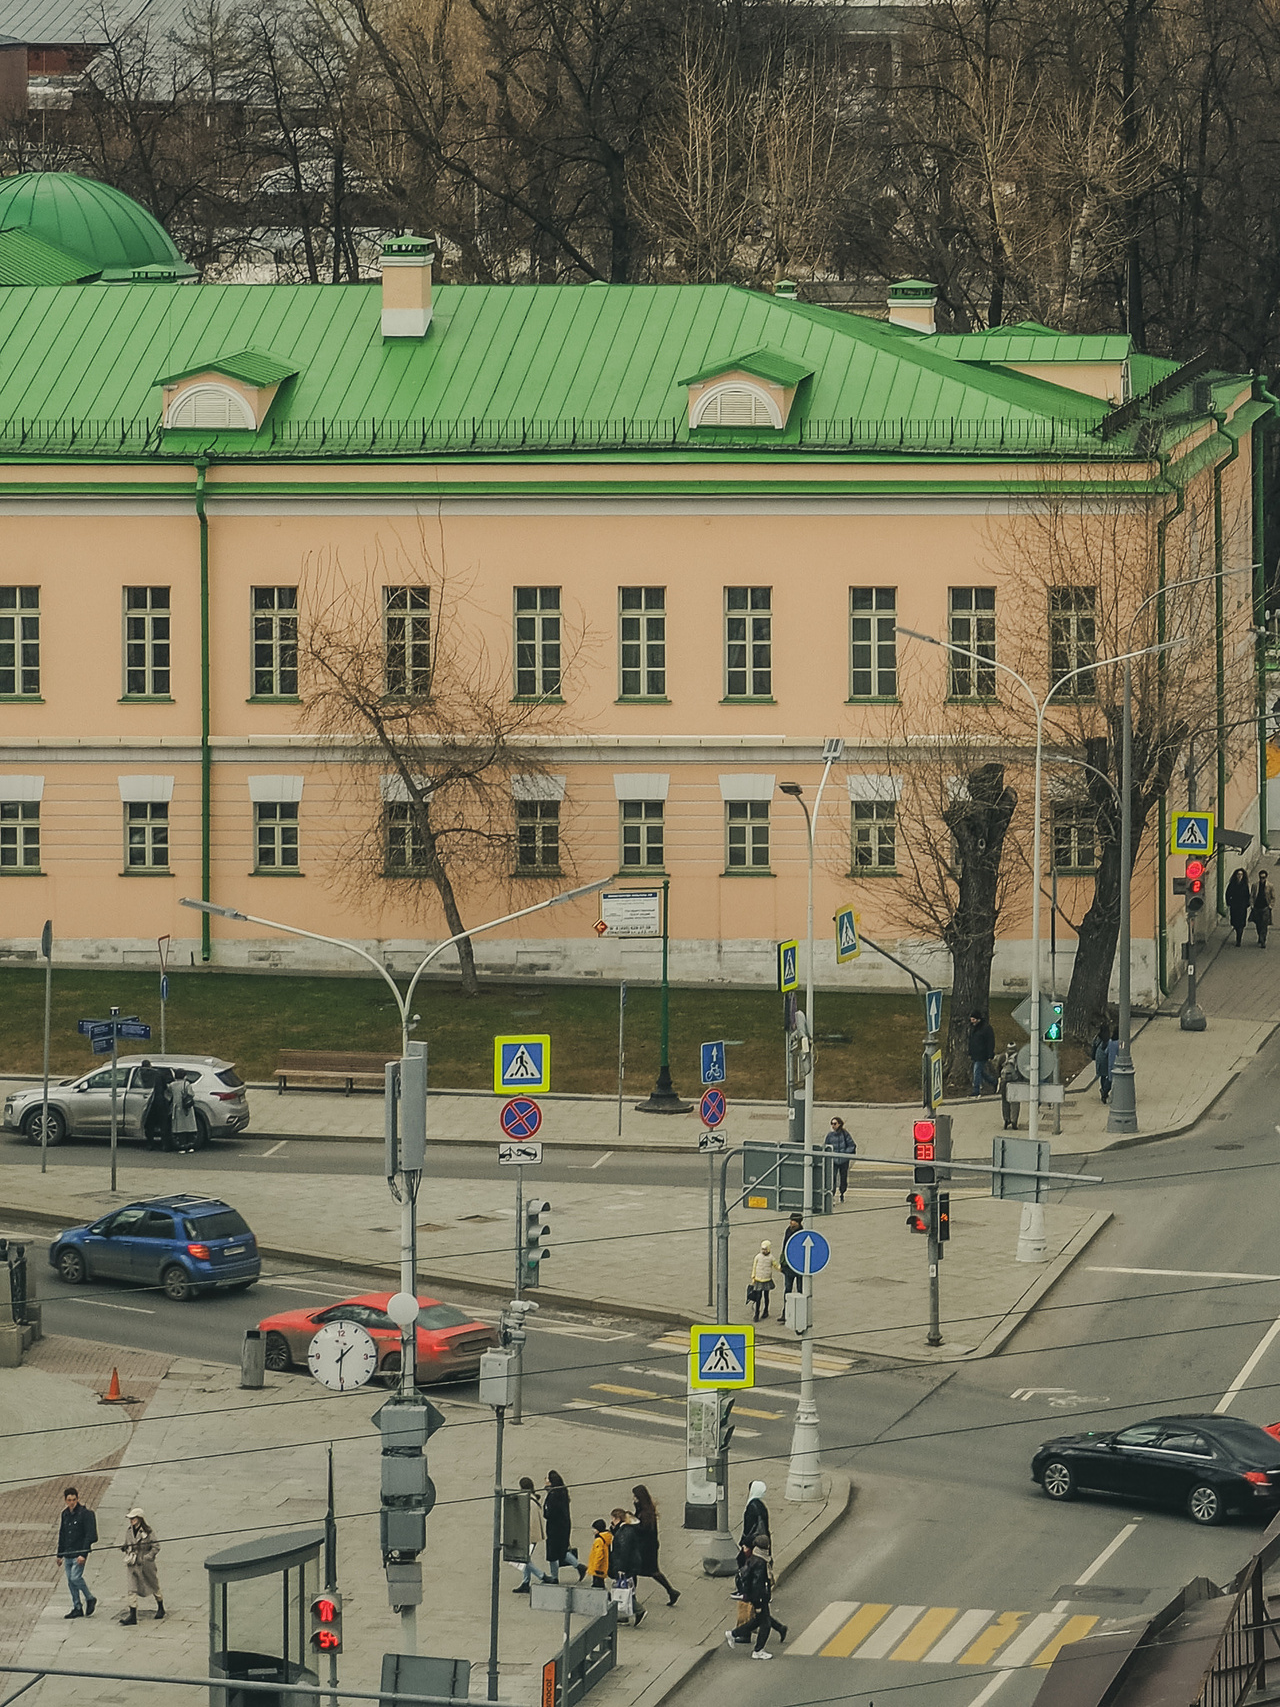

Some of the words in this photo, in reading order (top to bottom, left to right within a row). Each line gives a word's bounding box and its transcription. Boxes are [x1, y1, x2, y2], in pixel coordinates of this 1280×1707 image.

[1193, 880, 1201, 893] 2
[916, 1145, 934, 1160] 33
[320, 1630, 339, 1648] 54
